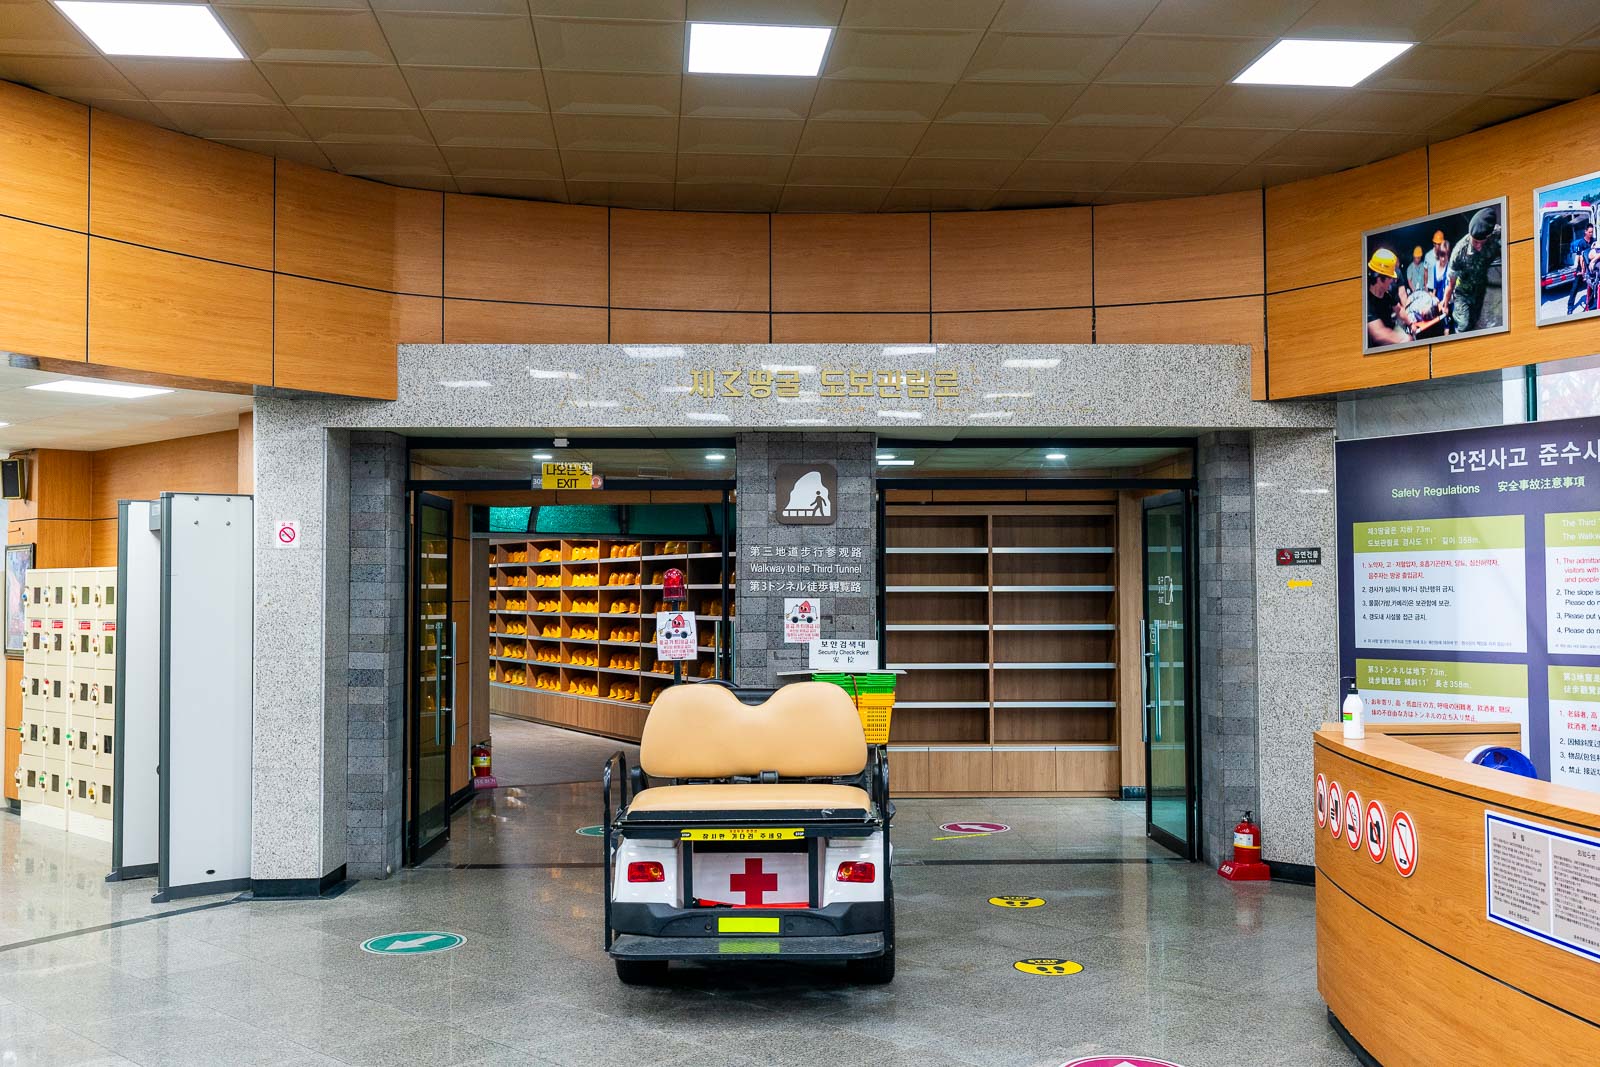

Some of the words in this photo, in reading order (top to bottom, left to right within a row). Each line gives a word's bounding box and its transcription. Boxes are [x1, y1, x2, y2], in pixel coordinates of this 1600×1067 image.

[820, 369, 960, 399] 도보관람로
[1448, 447, 1529, 473] 안전사고
[546, 464, 577, 476] 나오는
[557, 478, 579, 488] EXIT
[1498, 476, 1586, 492] 安全事故注意事項
[1391, 488, 1421, 499] Safety
[1423, 484, 1481, 497] Regulations
[750, 546, 862, 558] 第三地道步行参观路
[1294, 550, 1319, 559] 금연건물
[750, 563, 786, 575] Walkway
[787, 564, 796, 573] to
[797, 563, 811, 573] the
[812, 563, 833, 573] Third
[834, 564, 862, 574] Tunnel
[1564, 566, 1585, 574] visitors
[1586, 566, 1599, 574] with
[749, 581, 861, 593] 第3トンネル徒歩観覧路
[1564, 588, 1576, 596] The
[1577, 589, 1594, 597] slope
[1564, 612, 1585, 620] Please
[1585, 613, 1597, 621] put
